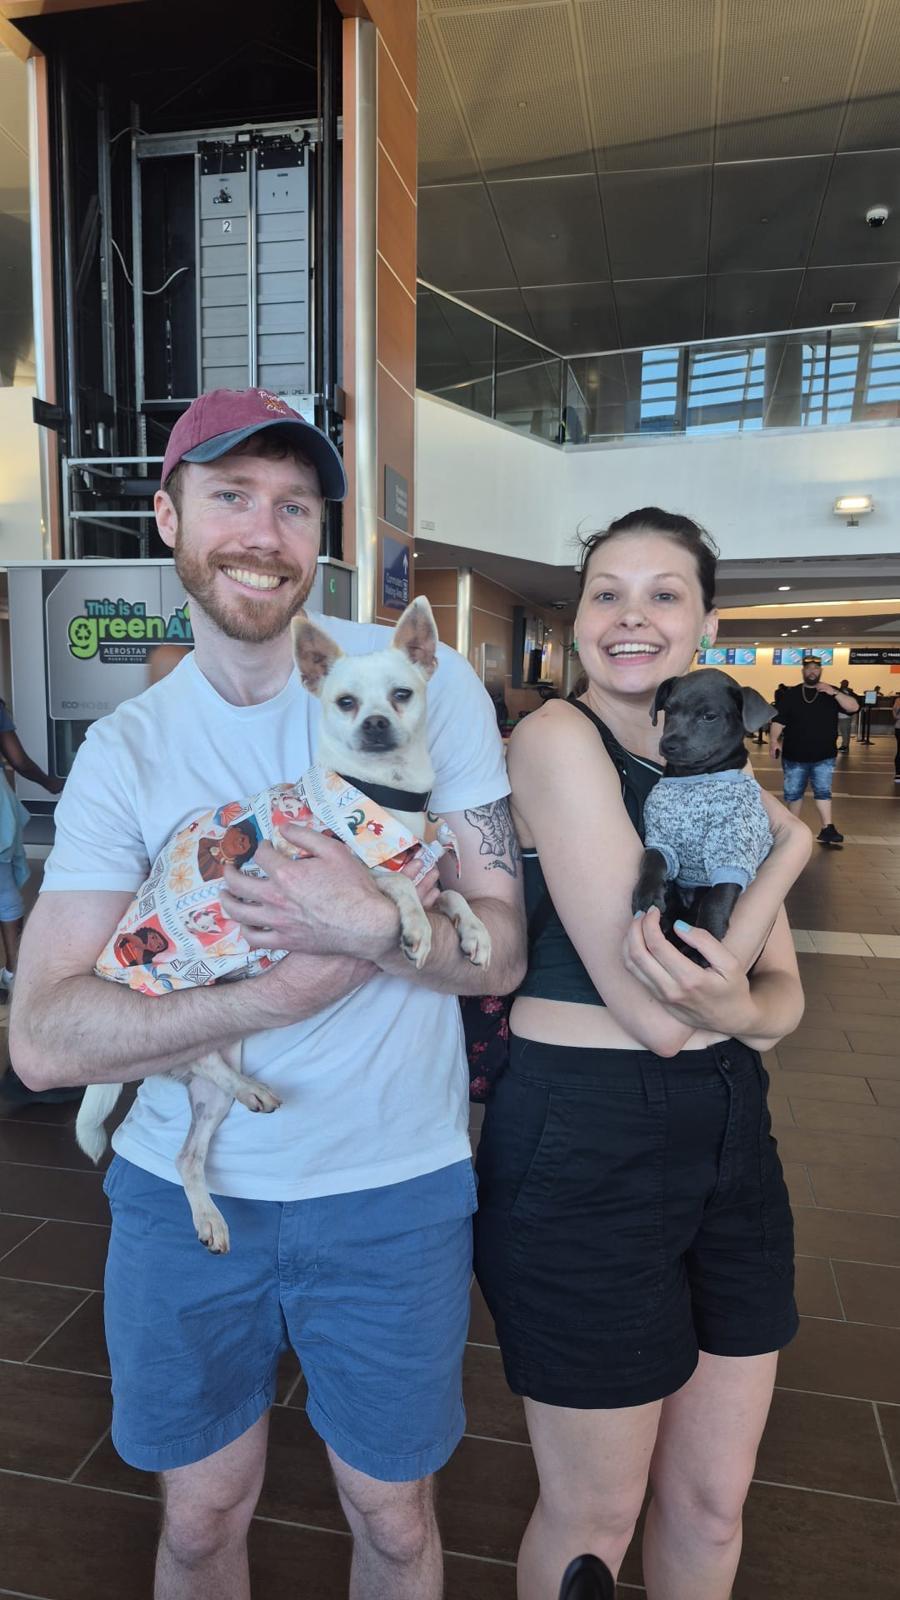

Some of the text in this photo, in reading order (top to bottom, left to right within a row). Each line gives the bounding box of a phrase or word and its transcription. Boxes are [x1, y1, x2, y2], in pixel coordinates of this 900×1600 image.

[224, 221, 231, 233] 2
[87, 600, 145, 616] This is a
[103, 647, 147, 655] AEROSTAR
